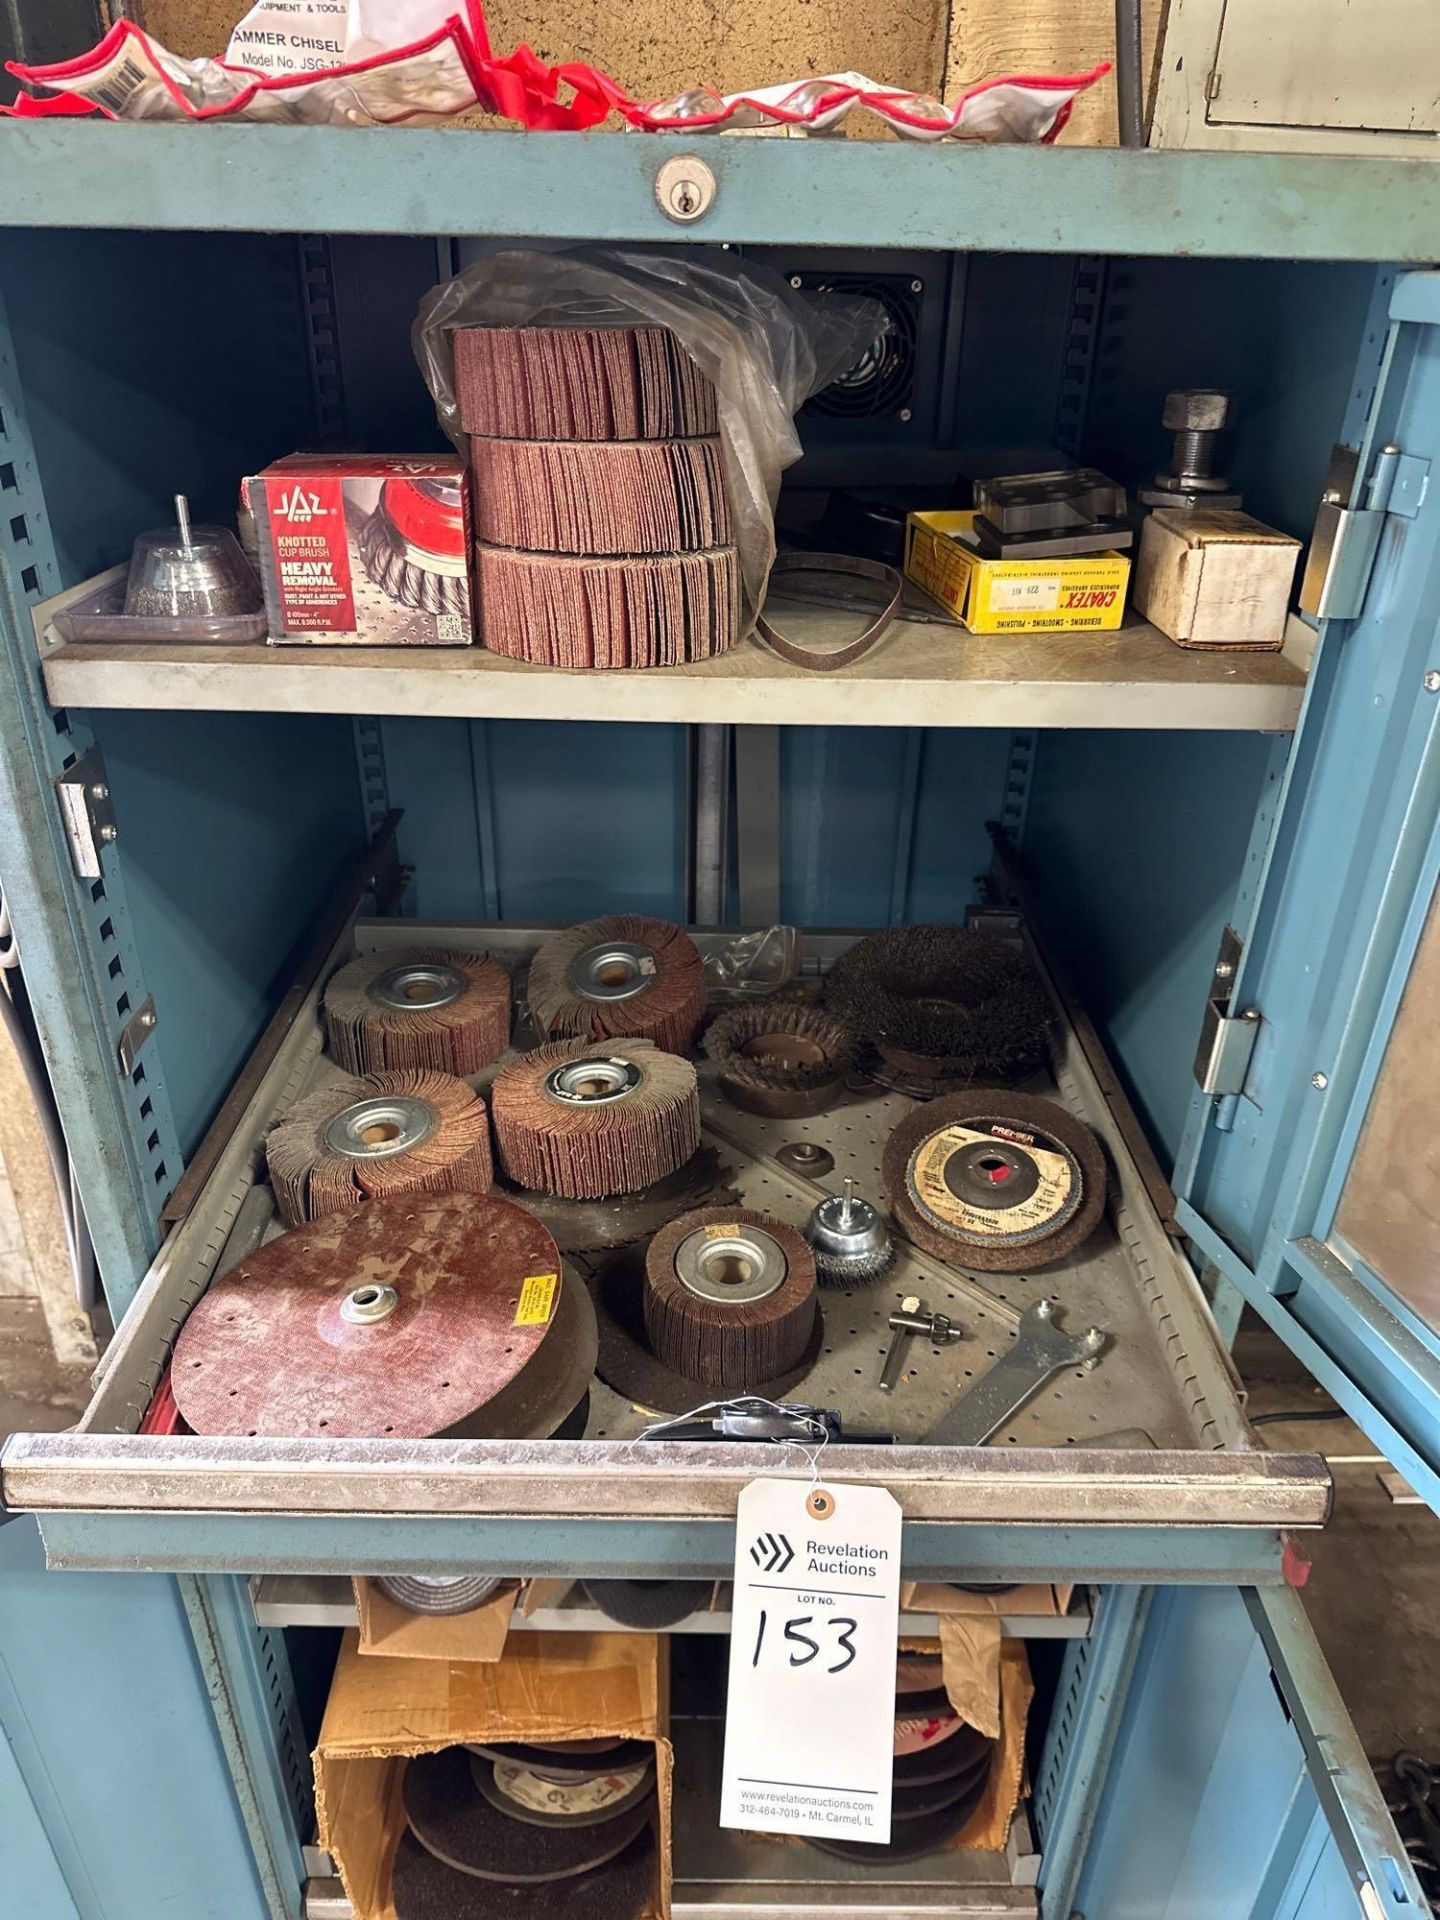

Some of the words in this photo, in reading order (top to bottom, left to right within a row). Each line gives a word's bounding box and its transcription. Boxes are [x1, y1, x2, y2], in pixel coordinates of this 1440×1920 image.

[260, 3, 301, 13] UIPMENT
[307, 4, 313, 13] &
[316, 4, 347, 14] TOOLS
[290, 36, 344, 53] CHISEL
[242, 52, 273, 67] Model
[277, 55, 297, 69] No.
[277, 536, 326, 547] KNOTTED
[279, 547, 298, 558] CUP
[299, 547, 330, 558] BRUSH
[281, 562, 333, 576] HEAVY
[282, 576, 338, 586] REMOVAL
[1065, 591, 1117, 609] CRATEX
[996, 620, 1025, 629] POLISHING
[1032, 618, 1064, 627] SMOOTHING
[1070, 617, 1102, 626] DEBURRING
[991, 1125, 1035, 1142] PREMIER
[806, 1540, 889, 1560] Revelation
[807, 1558, 877, 1577] Auctions
[797, 1595, 816, 1604] LOT
[818, 1597, 836, 1606] NO.
[752, 1609, 857, 1673] 153
[741, 1790, 873, 1811] www.revelationauctions.com
[740, 1803, 800, 1819] 312-464-7019
[808, 1810, 823, 1821] Mt.
[826, 1811, 862, 1826] Carmel,
[864, 1815, 874, 1826] IL
